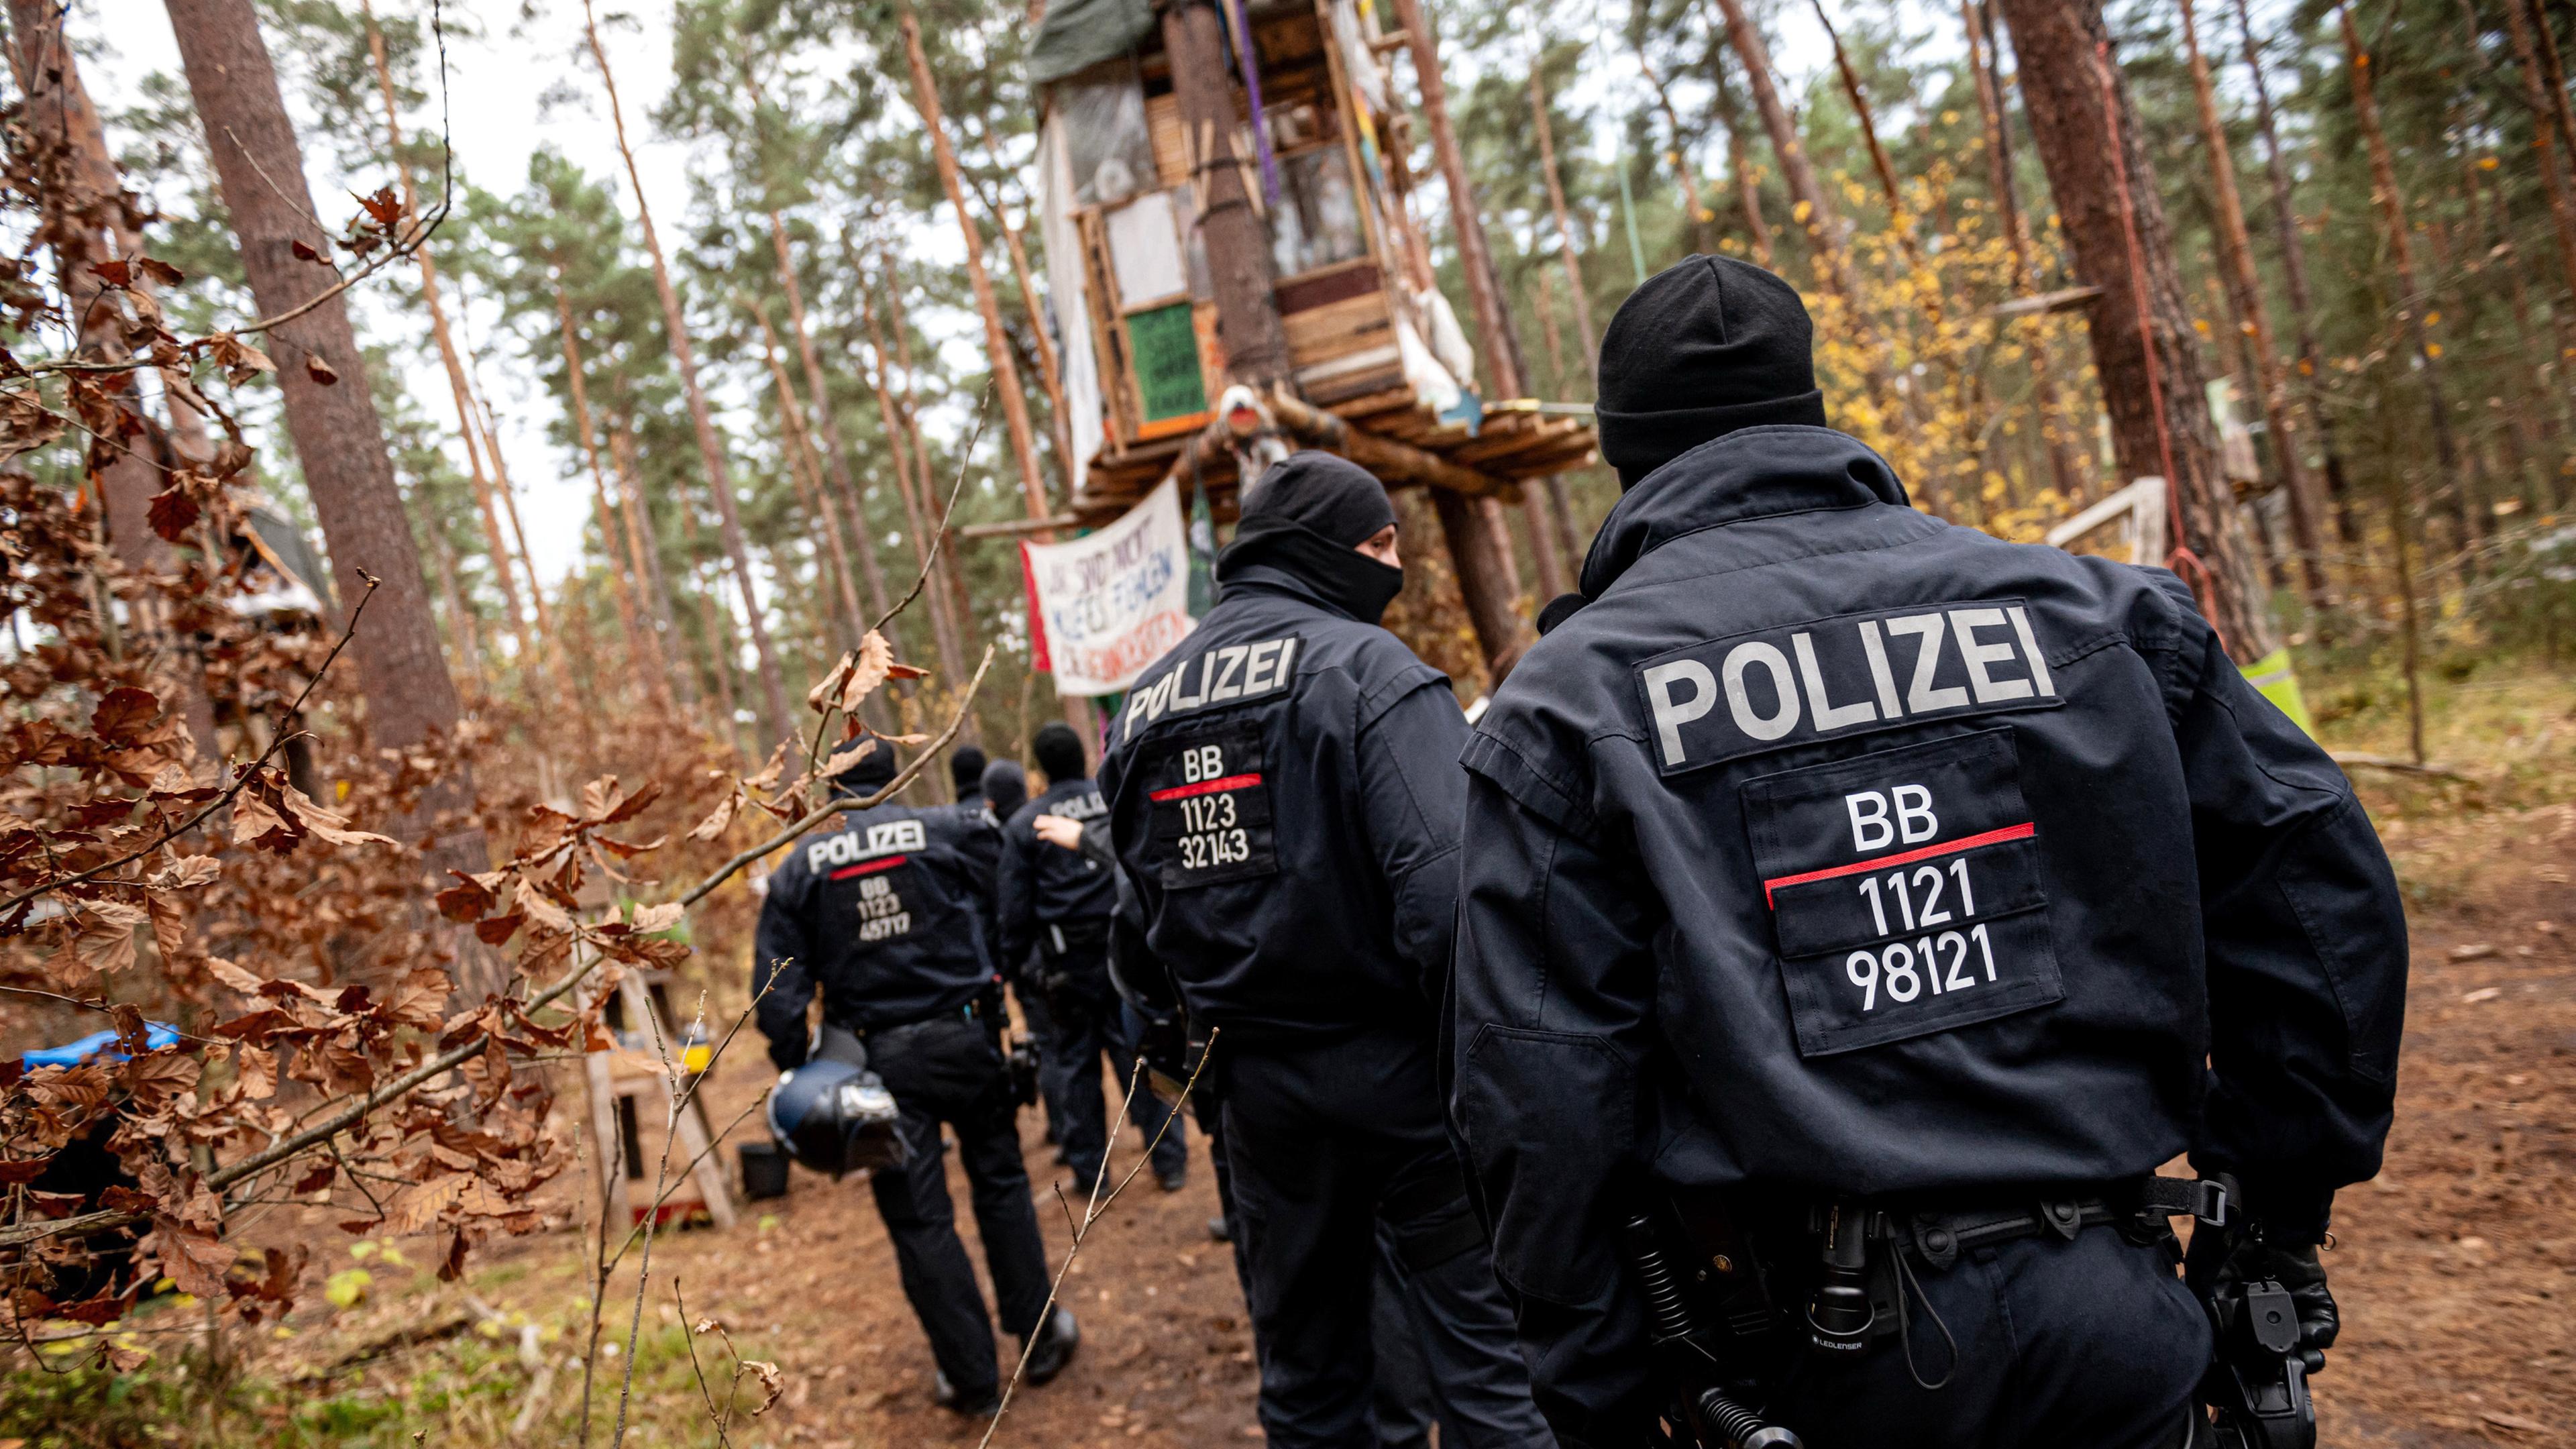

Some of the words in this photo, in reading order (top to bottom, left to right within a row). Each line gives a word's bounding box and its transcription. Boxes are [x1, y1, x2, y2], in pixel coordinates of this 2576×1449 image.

[1124, 637, 1296, 741] POLIZEI
[1643, 606, 2055, 765] POLIZEI
[1183, 745, 1224, 784] BB
[1180, 793, 1236, 833] 1123
[1845, 784, 1938, 852] BB
[808, 820, 926, 875] POLIZEI
[1179, 828, 1249, 869] 32143
[1859, 858, 1974, 936] 1121
[1846, 923, 1996, 1011] 98121
[1819, 1339, 1862, 1350] LEDLENSER
